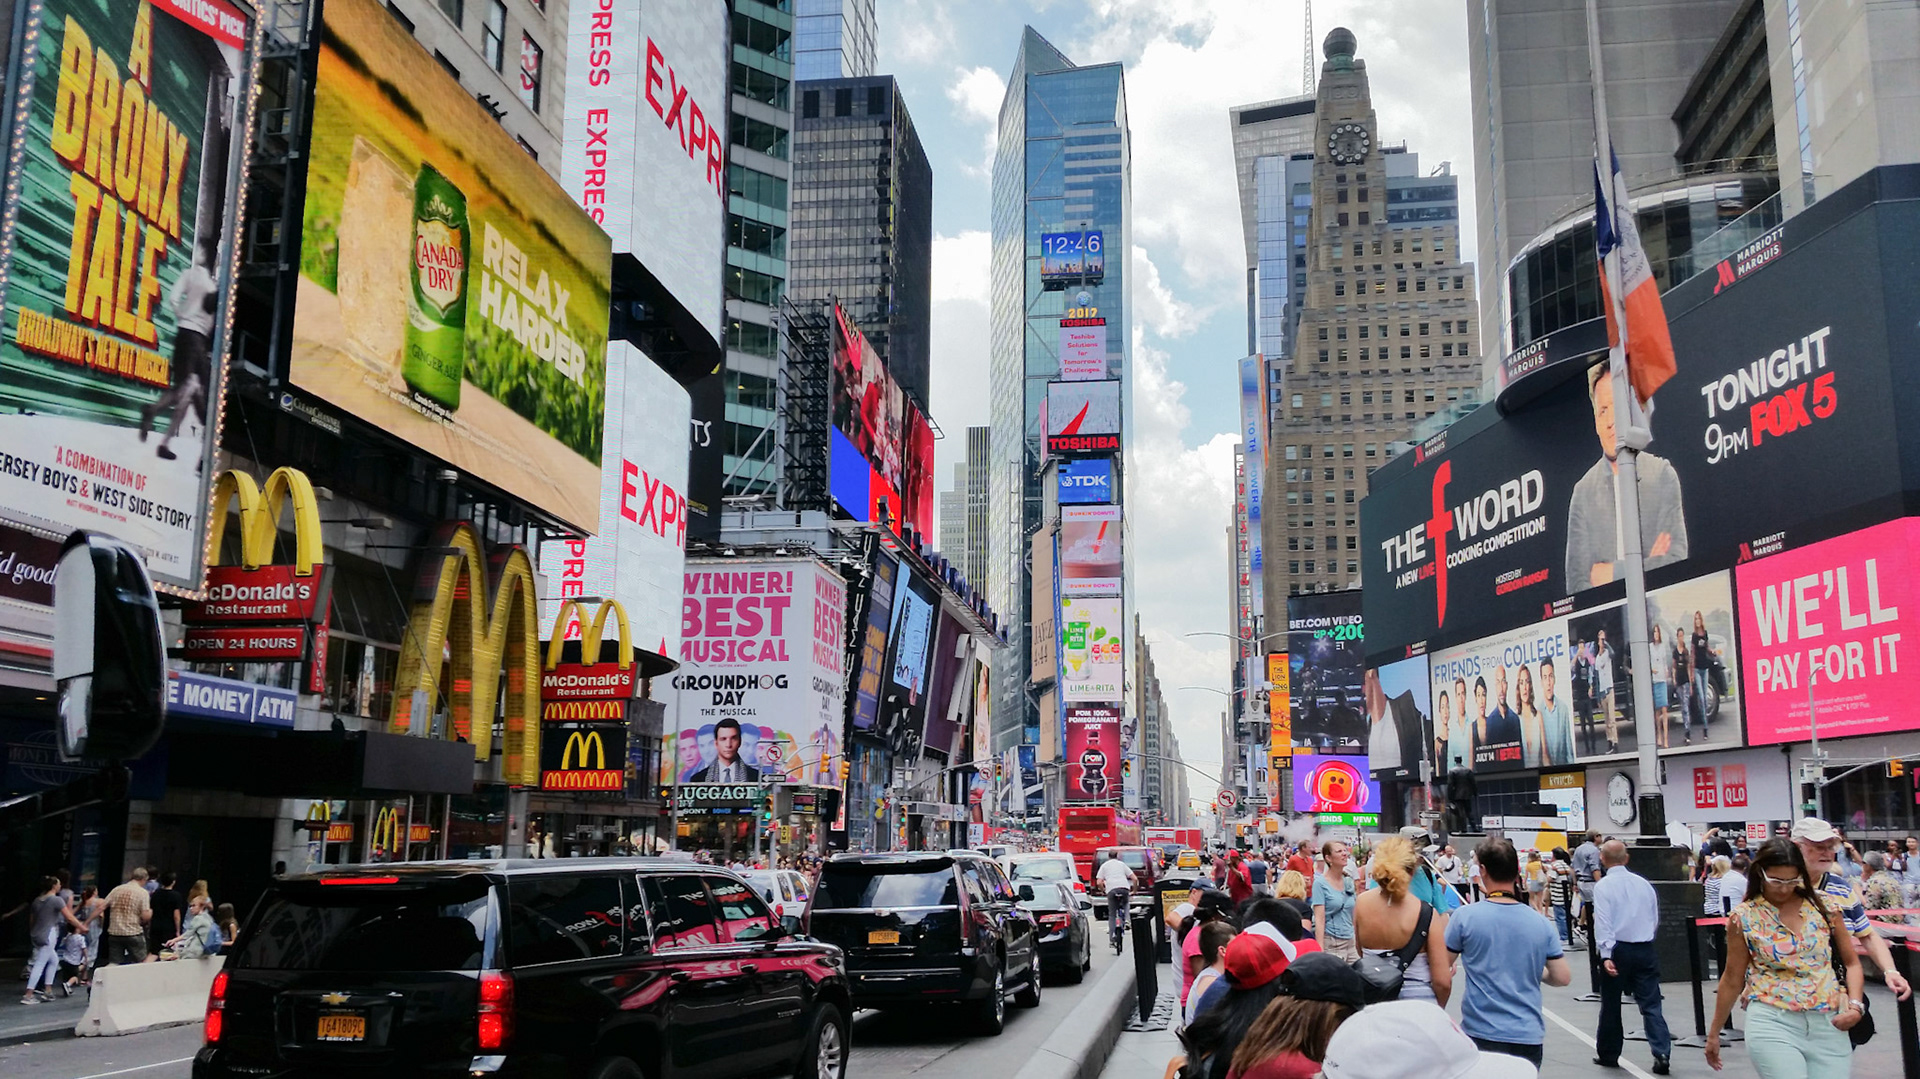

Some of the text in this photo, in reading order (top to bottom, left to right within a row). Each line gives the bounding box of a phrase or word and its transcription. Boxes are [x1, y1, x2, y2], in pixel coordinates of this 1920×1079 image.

[219, 11, 245, 40] PICK
[128, 0, 152, 96] A
[644, 35, 723, 198] EXPR
[50, 13, 190, 246] BRONX
[583, 108, 609, 226] EXPRES
[415, 234, 465, 271] CANADA
[1044, 235, 1101, 255] 12:46
[1736, 226, 1785, 263] MARRIOTT
[64, 170, 169, 350] TALE
[1737, 244, 1781, 277] MARQUIS
[428, 266, 455, 292] DRY
[482, 221, 571, 331] RELAX
[1061, 318, 1105, 328] TOSHIBA
[1068, 307, 1098, 319] 2017
[479, 269, 586, 388] HARDER
[95, 334, 120, 373] NEW
[118, 342, 137, 379] HIT
[411, 343, 444, 374] GINGER
[1063, 358, 1102, 366] Tomorrow's
[1507, 338, 1550, 368] MARRIOTT
[1508, 354, 1544, 379] MARQUIS
[1701, 325, 1831, 419] TONIGHT
[1750, 382, 1812, 447] FOX
[1812, 371, 1838, 419] 5
[1048, 436, 1119, 450] TOSHIBA
[1424, 430, 1448, 448] MARRIOTT
[1424, 441, 1446, 458] MARQUIS
[65, 451, 133, 488] COMBINATION
[135, 475, 147, 492] OF
[1072, 475, 1108, 487] TDK
[41, 467, 78, 495] BOYS
[79, 480, 90, 498] &
[92, 482, 126, 508] WEST
[128, 495, 153, 517] SIDE
[620, 457, 687, 554] EXPR
[1381, 523, 1426, 573] THE
[1454, 469, 1544, 542] WORD
[1752, 530, 1786, 547] MARRIOTT
[1753, 541, 1783, 557] MARQUIS
[1395, 515, 1546, 589] A NEW LIVE COOKING COMPETITION!
[12, 562, 59, 586] good
[682, 571, 794, 596] WINNER!
[1240, 573, 1250, 585] &
[1495, 567, 1523, 586] HOSTED BY
[1495, 568, 1550, 596] GORDON RAMSAY
[209, 582, 311, 601] cDonald's
[561, 537, 586, 641] PRES
[205, 602, 288, 615] Restaurant
[1751, 558, 1899, 647] WE'LL
[680, 595, 792, 639] BEST
[813, 597, 843, 650] BEST
[1289, 614, 1363, 630] BET.COM VIDEO
[187, 636, 297, 650] OPEN 24 HOURS
[1069, 635, 1084, 643] RITA
[812, 640, 841, 675] MUSICAL
[1434, 655, 1482, 686] FRIENDS
[1481, 657, 1503, 670] FROM
[1503, 634, 1564, 668] COLLEGE
[1756, 632, 1901, 694] PAY FOR IT
[542, 672, 630, 688] McDonald's
[1272, 673, 1286, 682] LION
[183, 685, 251, 715] MONEY
[257, 696, 293, 721] ATM
[556, 687, 615, 696] Restaurant
[712, 690, 746, 706] DAY
[821, 696, 831, 712] DAY
[700, 707, 757, 717] THE MUSICAL
[1475, 751, 1495, 763] JULY 14
[1723, 770, 1746, 786] UNI
[679, 799, 695, 807] NY
[1724, 788, 1746, 805] QLO
[321, 1018, 364, 1035] T641809C
